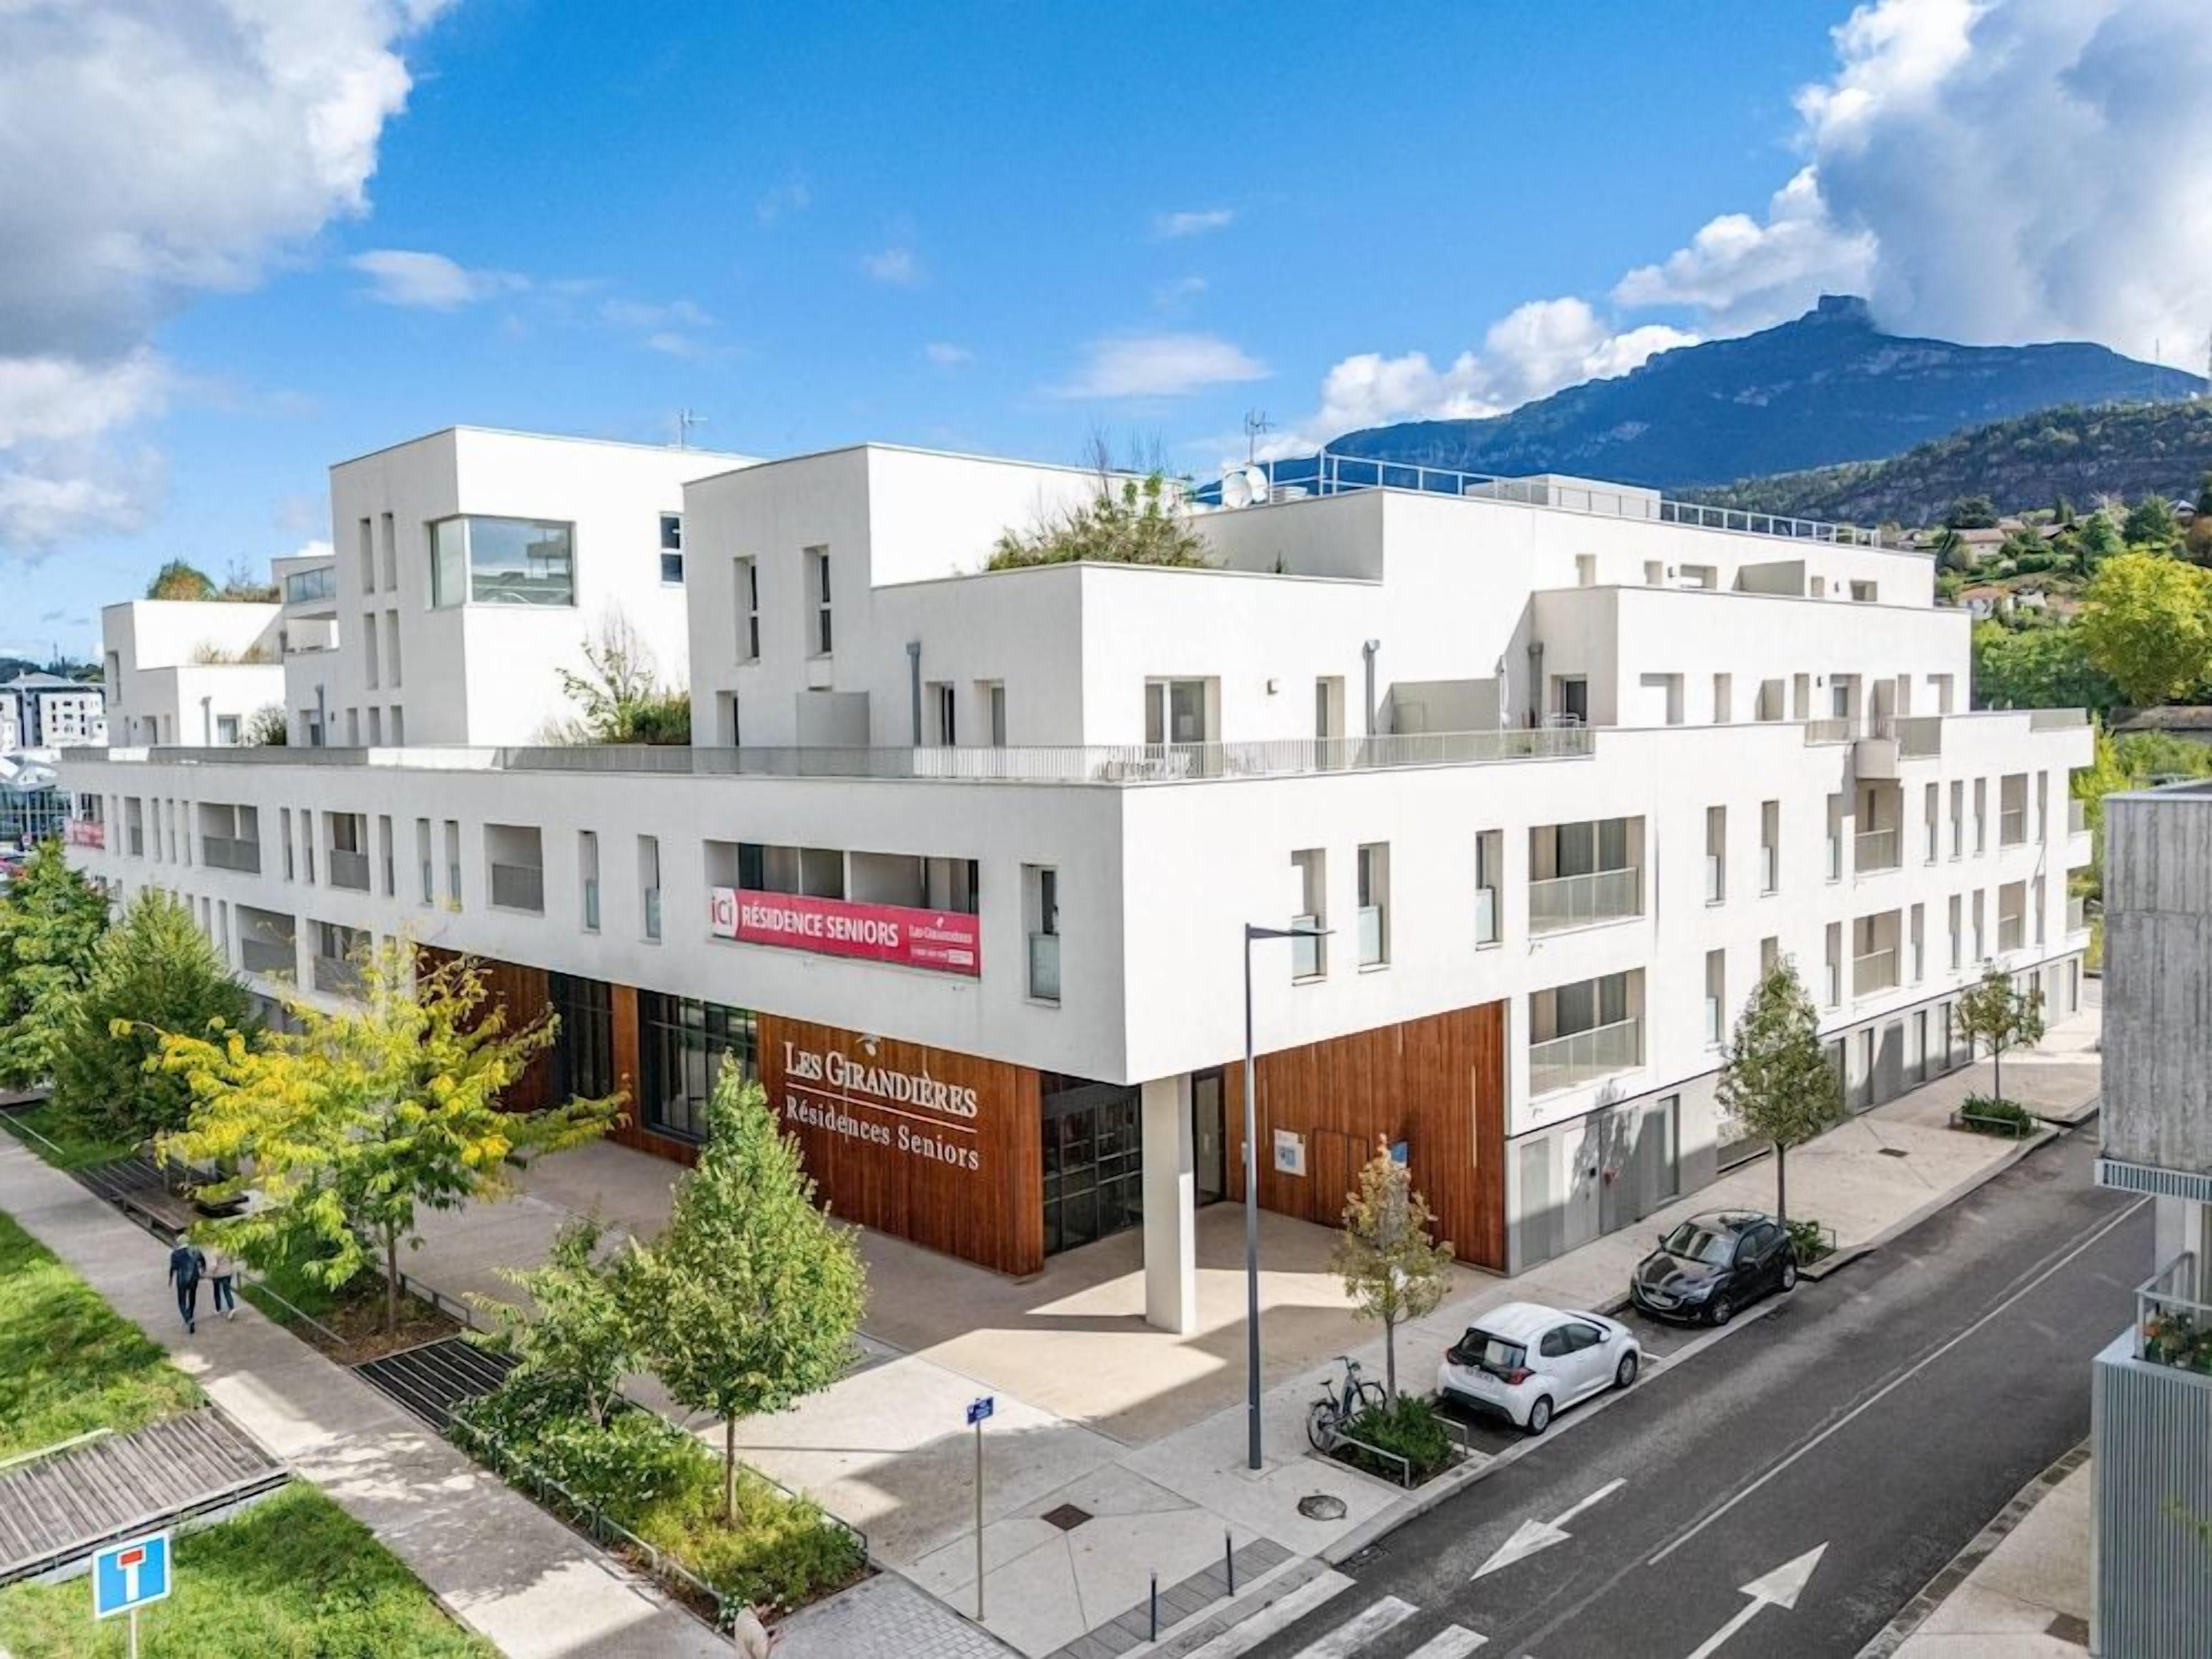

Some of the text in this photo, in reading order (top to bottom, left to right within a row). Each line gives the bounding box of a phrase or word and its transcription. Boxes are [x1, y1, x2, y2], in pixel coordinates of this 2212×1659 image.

[742, 900, 823, 937] RÉSIDENCE
[827, 915, 899, 947] SENIORS
[786, 1094, 979, 1171] Résidences Seniors
